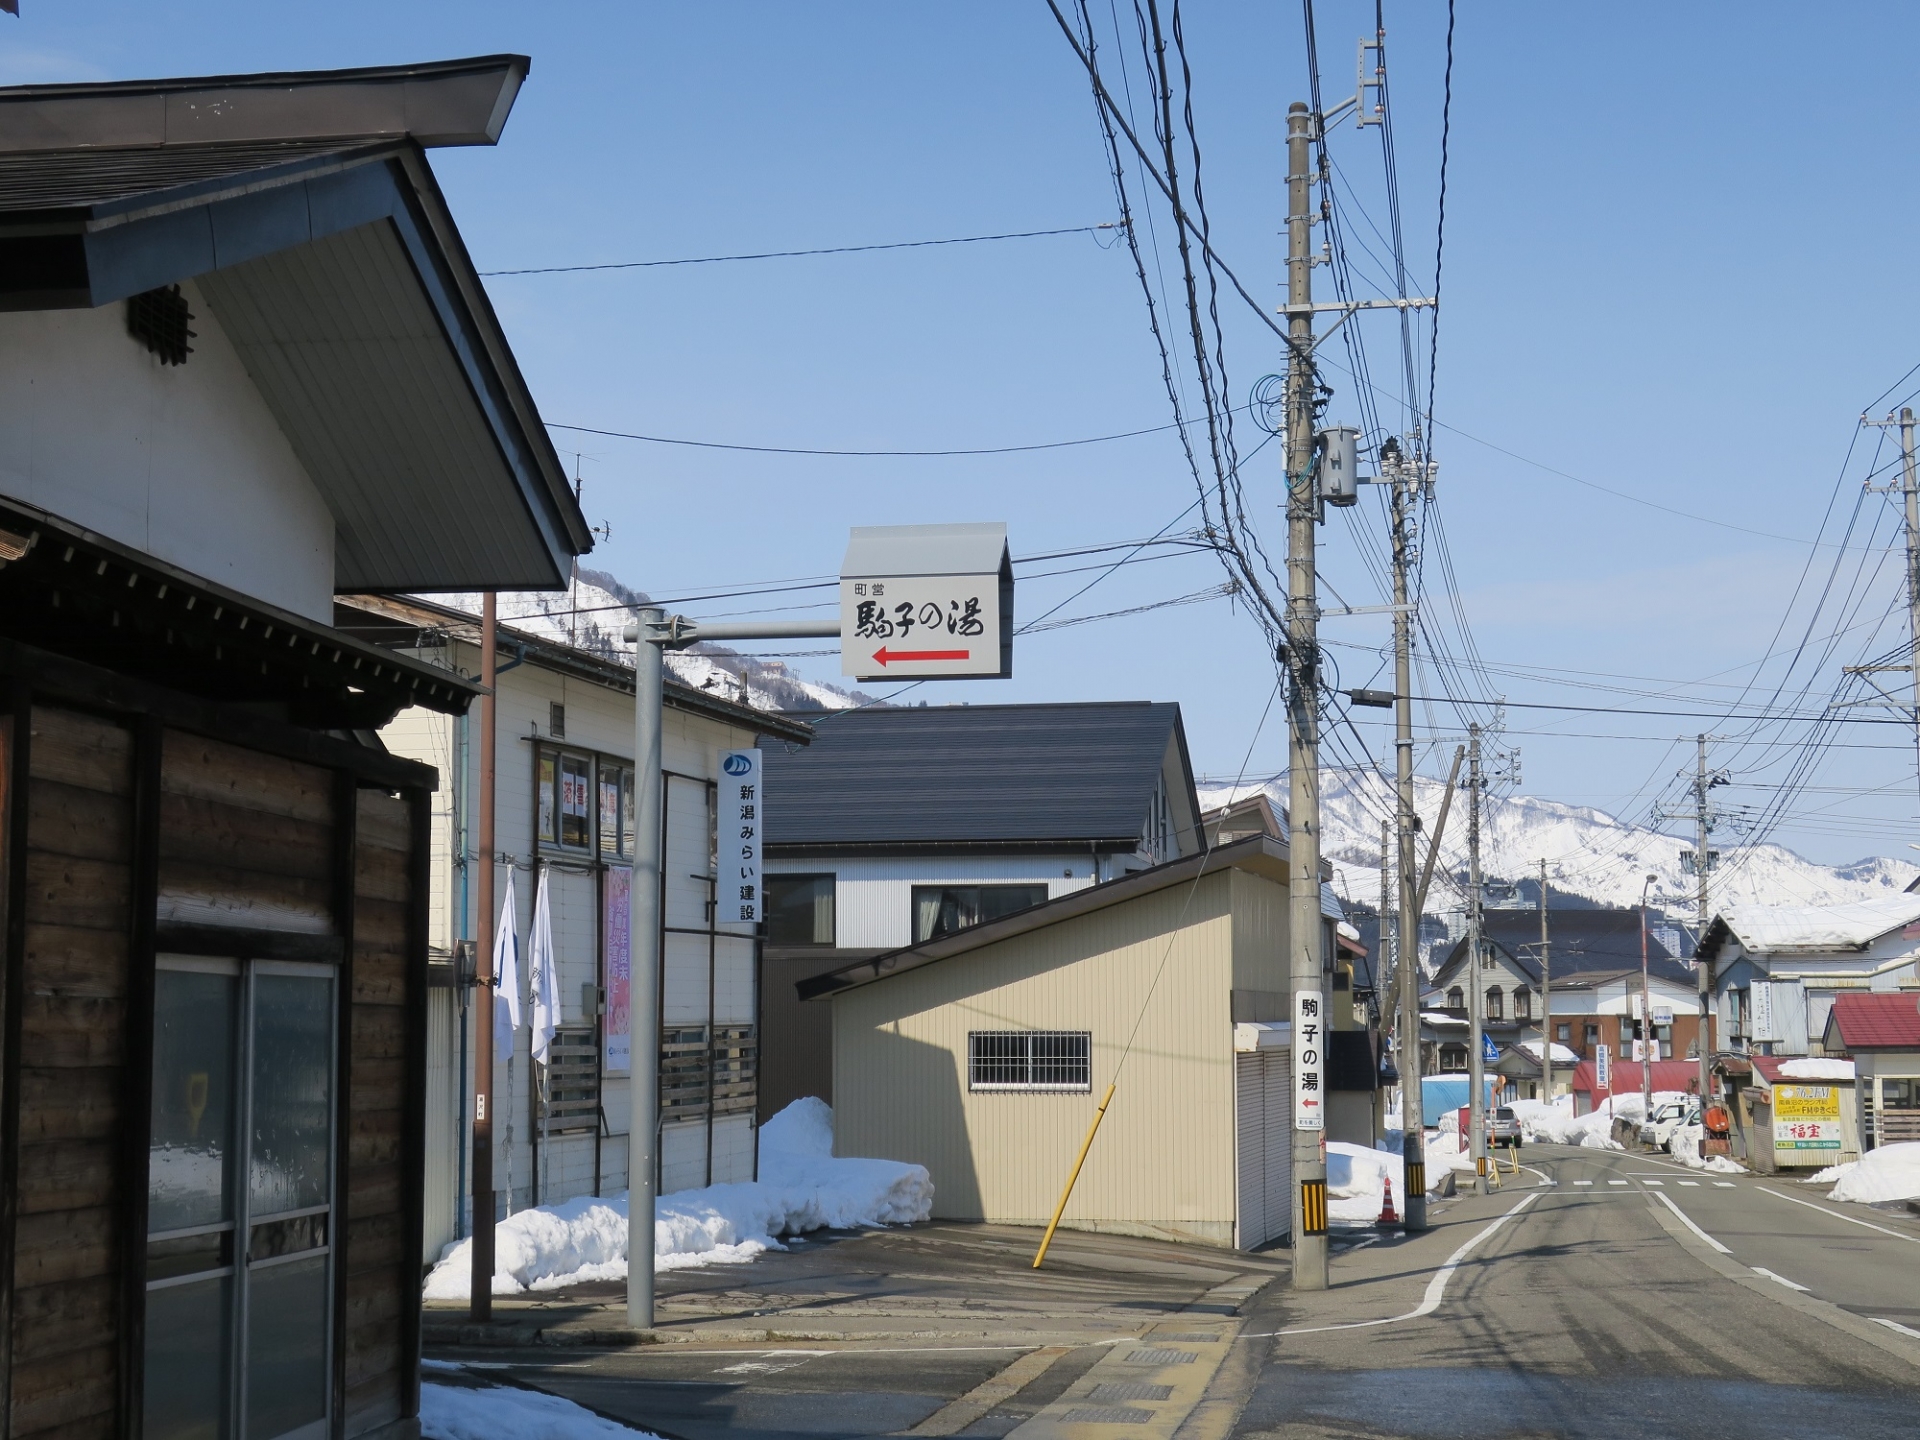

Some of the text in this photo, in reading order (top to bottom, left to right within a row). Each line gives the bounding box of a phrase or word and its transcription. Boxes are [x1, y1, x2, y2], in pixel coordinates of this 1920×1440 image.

[854, 583, 885, 596] 町営
[854, 597, 984, 639] 駒子の湯
[740, 785, 755, 921] 新潟みらい建設
[1302, 998, 1319, 1091] 駒子の湯
[1802, 1106, 1838, 1114] FMゆきくに
[1790, 1123, 1821, 1139] 福宝
